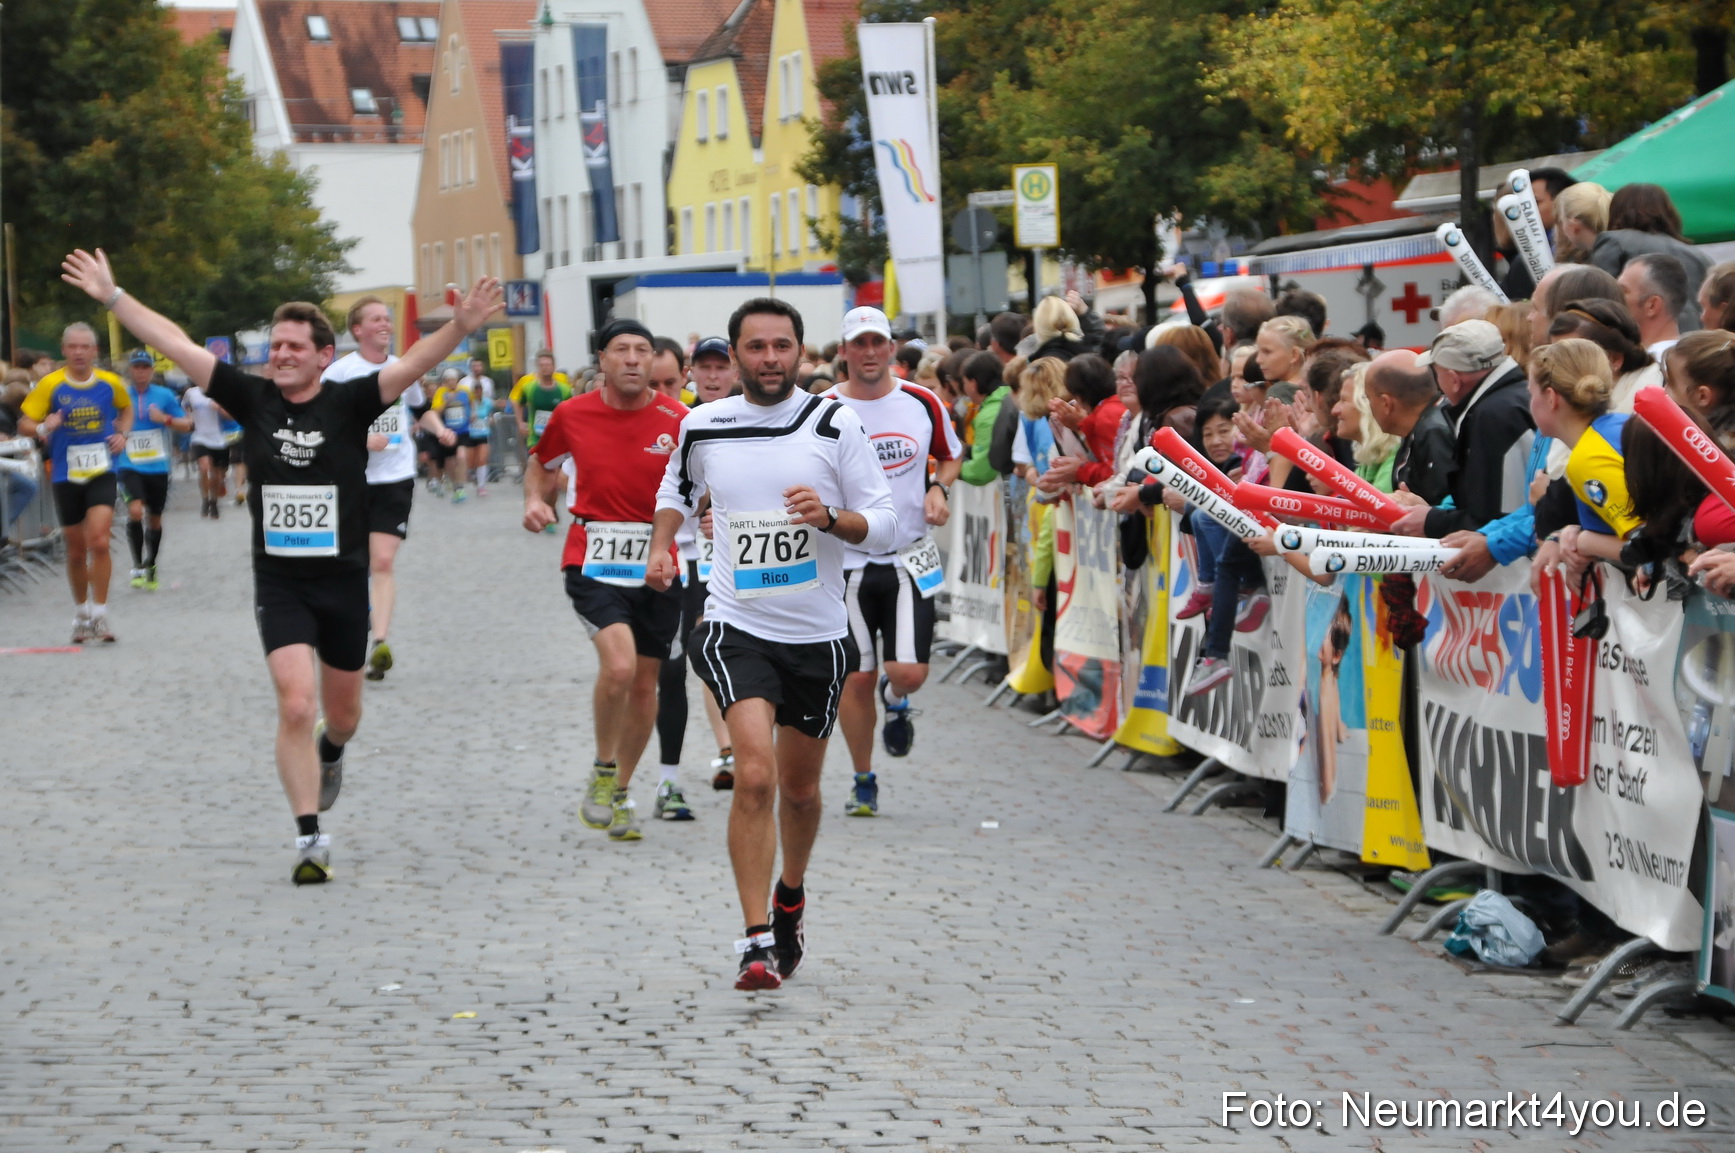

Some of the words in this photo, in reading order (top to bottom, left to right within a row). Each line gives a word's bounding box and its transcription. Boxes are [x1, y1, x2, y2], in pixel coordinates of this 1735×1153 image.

[368, 417, 398, 433] 658
[710, 416, 737, 424] uhlsport
[280, 441, 316, 459] Berlin
[874, 440, 902, 451] ART
[75, 453, 98, 468] 171
[1168, 472, 1210, 505] BMW
[1331, 470, 1358, 494] BKK
[1354, 491, 1386, 511] Audi
[269, 503, 328, 528] 2852
[1313, 503, 1342, 518] BKK
[1346, 505, 1377, 523] Audi
[729, 520, 757, 530] PARTL
[758, 519, 791, 528] Neuma
[284, 535, 311, 545] Peter
[592, 537, 648, 560] 2147
[737, 529, 809, 565] 2762
[600, 566, 633, 577] Johann
[1355, 555, 1399, 572] BMW
[761, 572, 789, 585] Rico
[1267, 661, 1292, 687] adt
